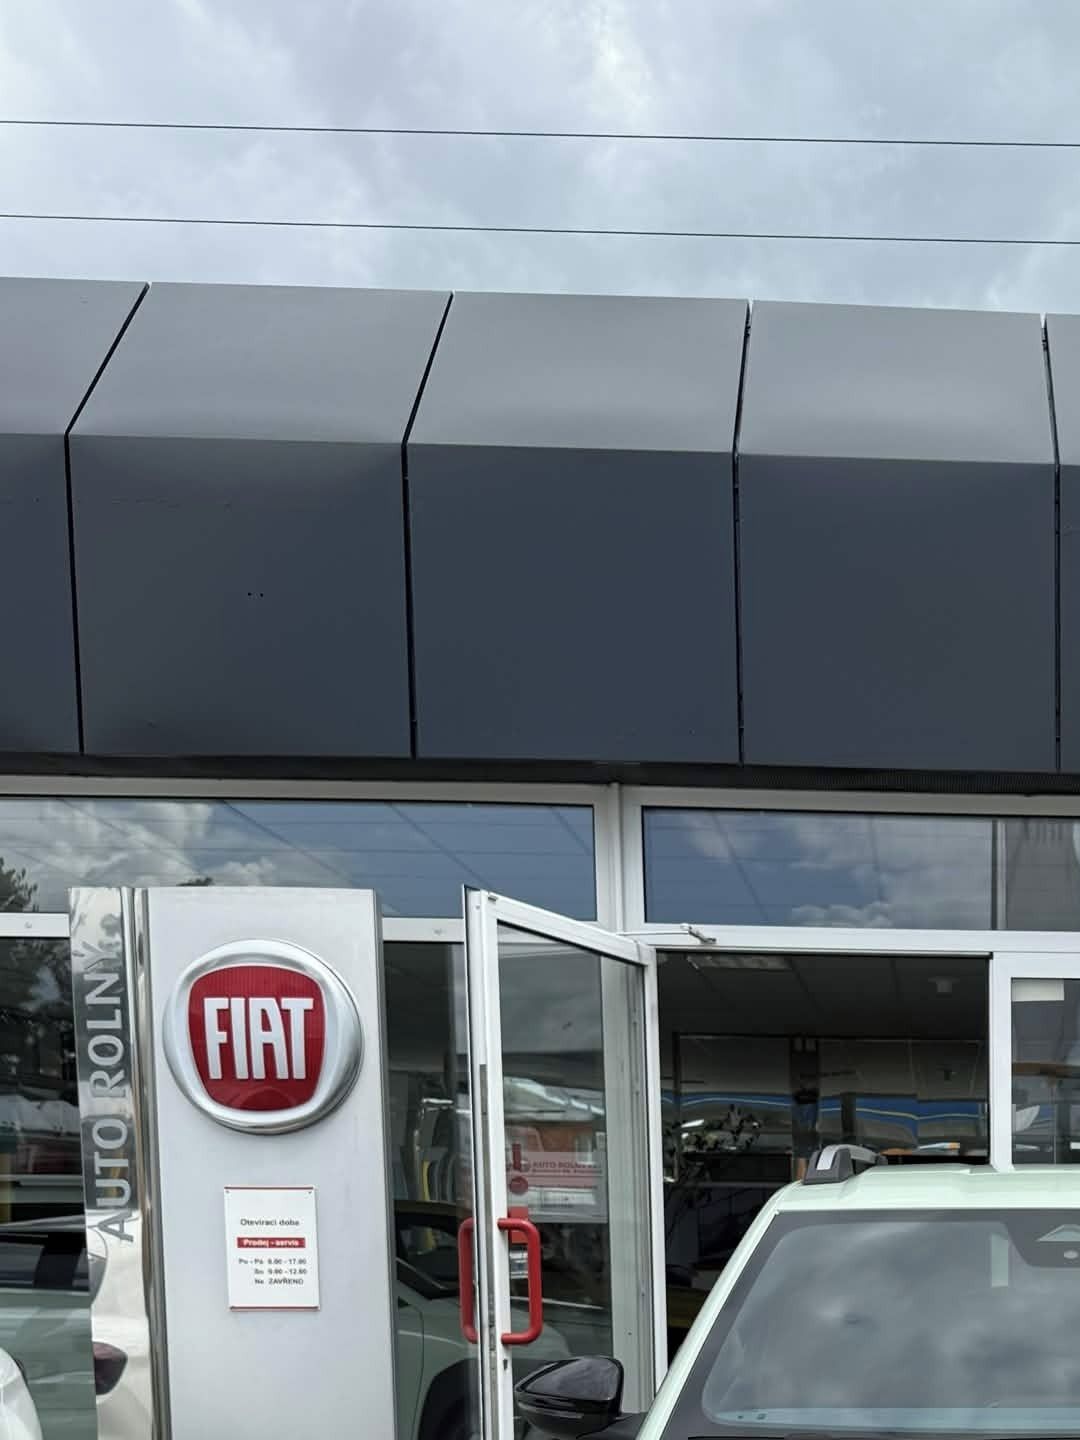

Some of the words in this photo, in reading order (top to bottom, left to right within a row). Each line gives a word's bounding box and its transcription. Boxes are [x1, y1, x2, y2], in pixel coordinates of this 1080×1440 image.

[204, 997, 314, 1080] FIAT
[92, 1118, 134, 1242] AUTO
[275, 1239, 299, 1247] servis
[279, 1217, 300, 1226] doba
